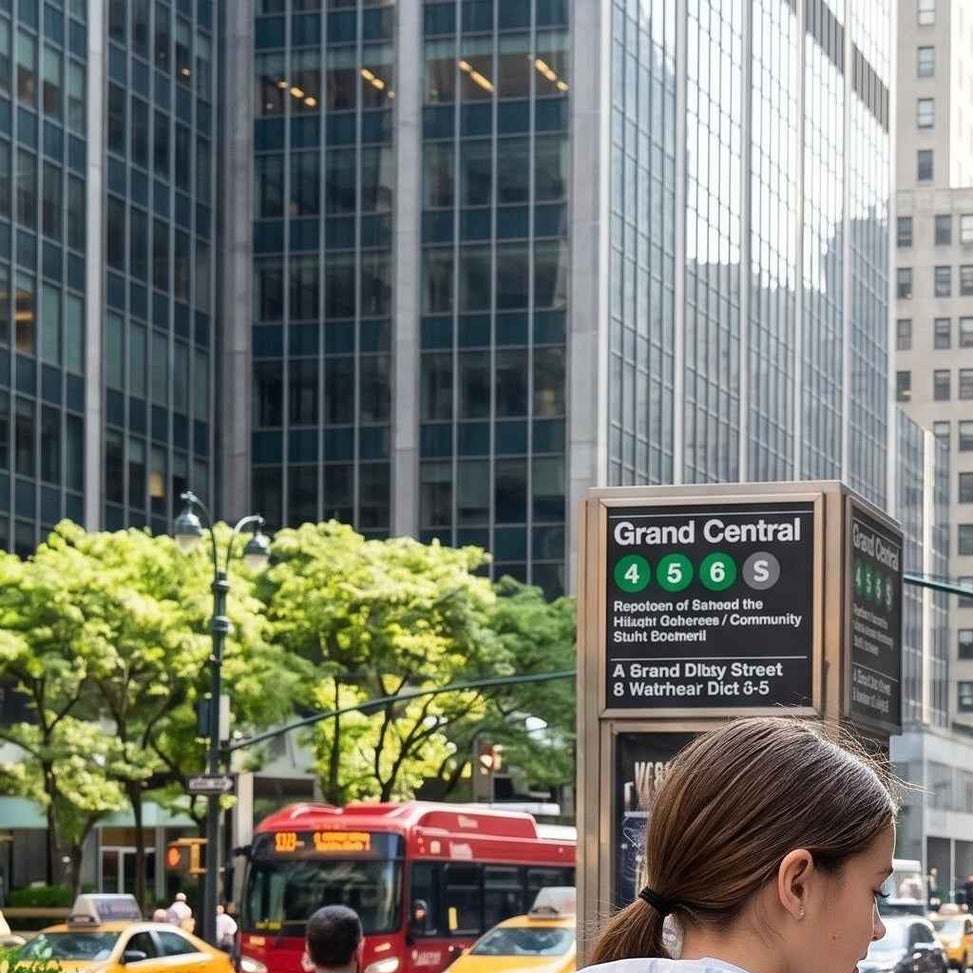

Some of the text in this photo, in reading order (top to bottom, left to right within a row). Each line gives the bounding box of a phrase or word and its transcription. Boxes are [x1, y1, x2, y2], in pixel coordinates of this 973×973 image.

[614, 517, 800, 546] Grand Central
[624, 560, 769, 584] 4 5 6 S
[676, 599, 689, 611] of
[742, 598, 763, 610] the
[729, 613, 802, 628] Community
[612, 664, 625, 678] A
[730, 662, 783, 677] Street
[613, 682, 624, 696] 8
